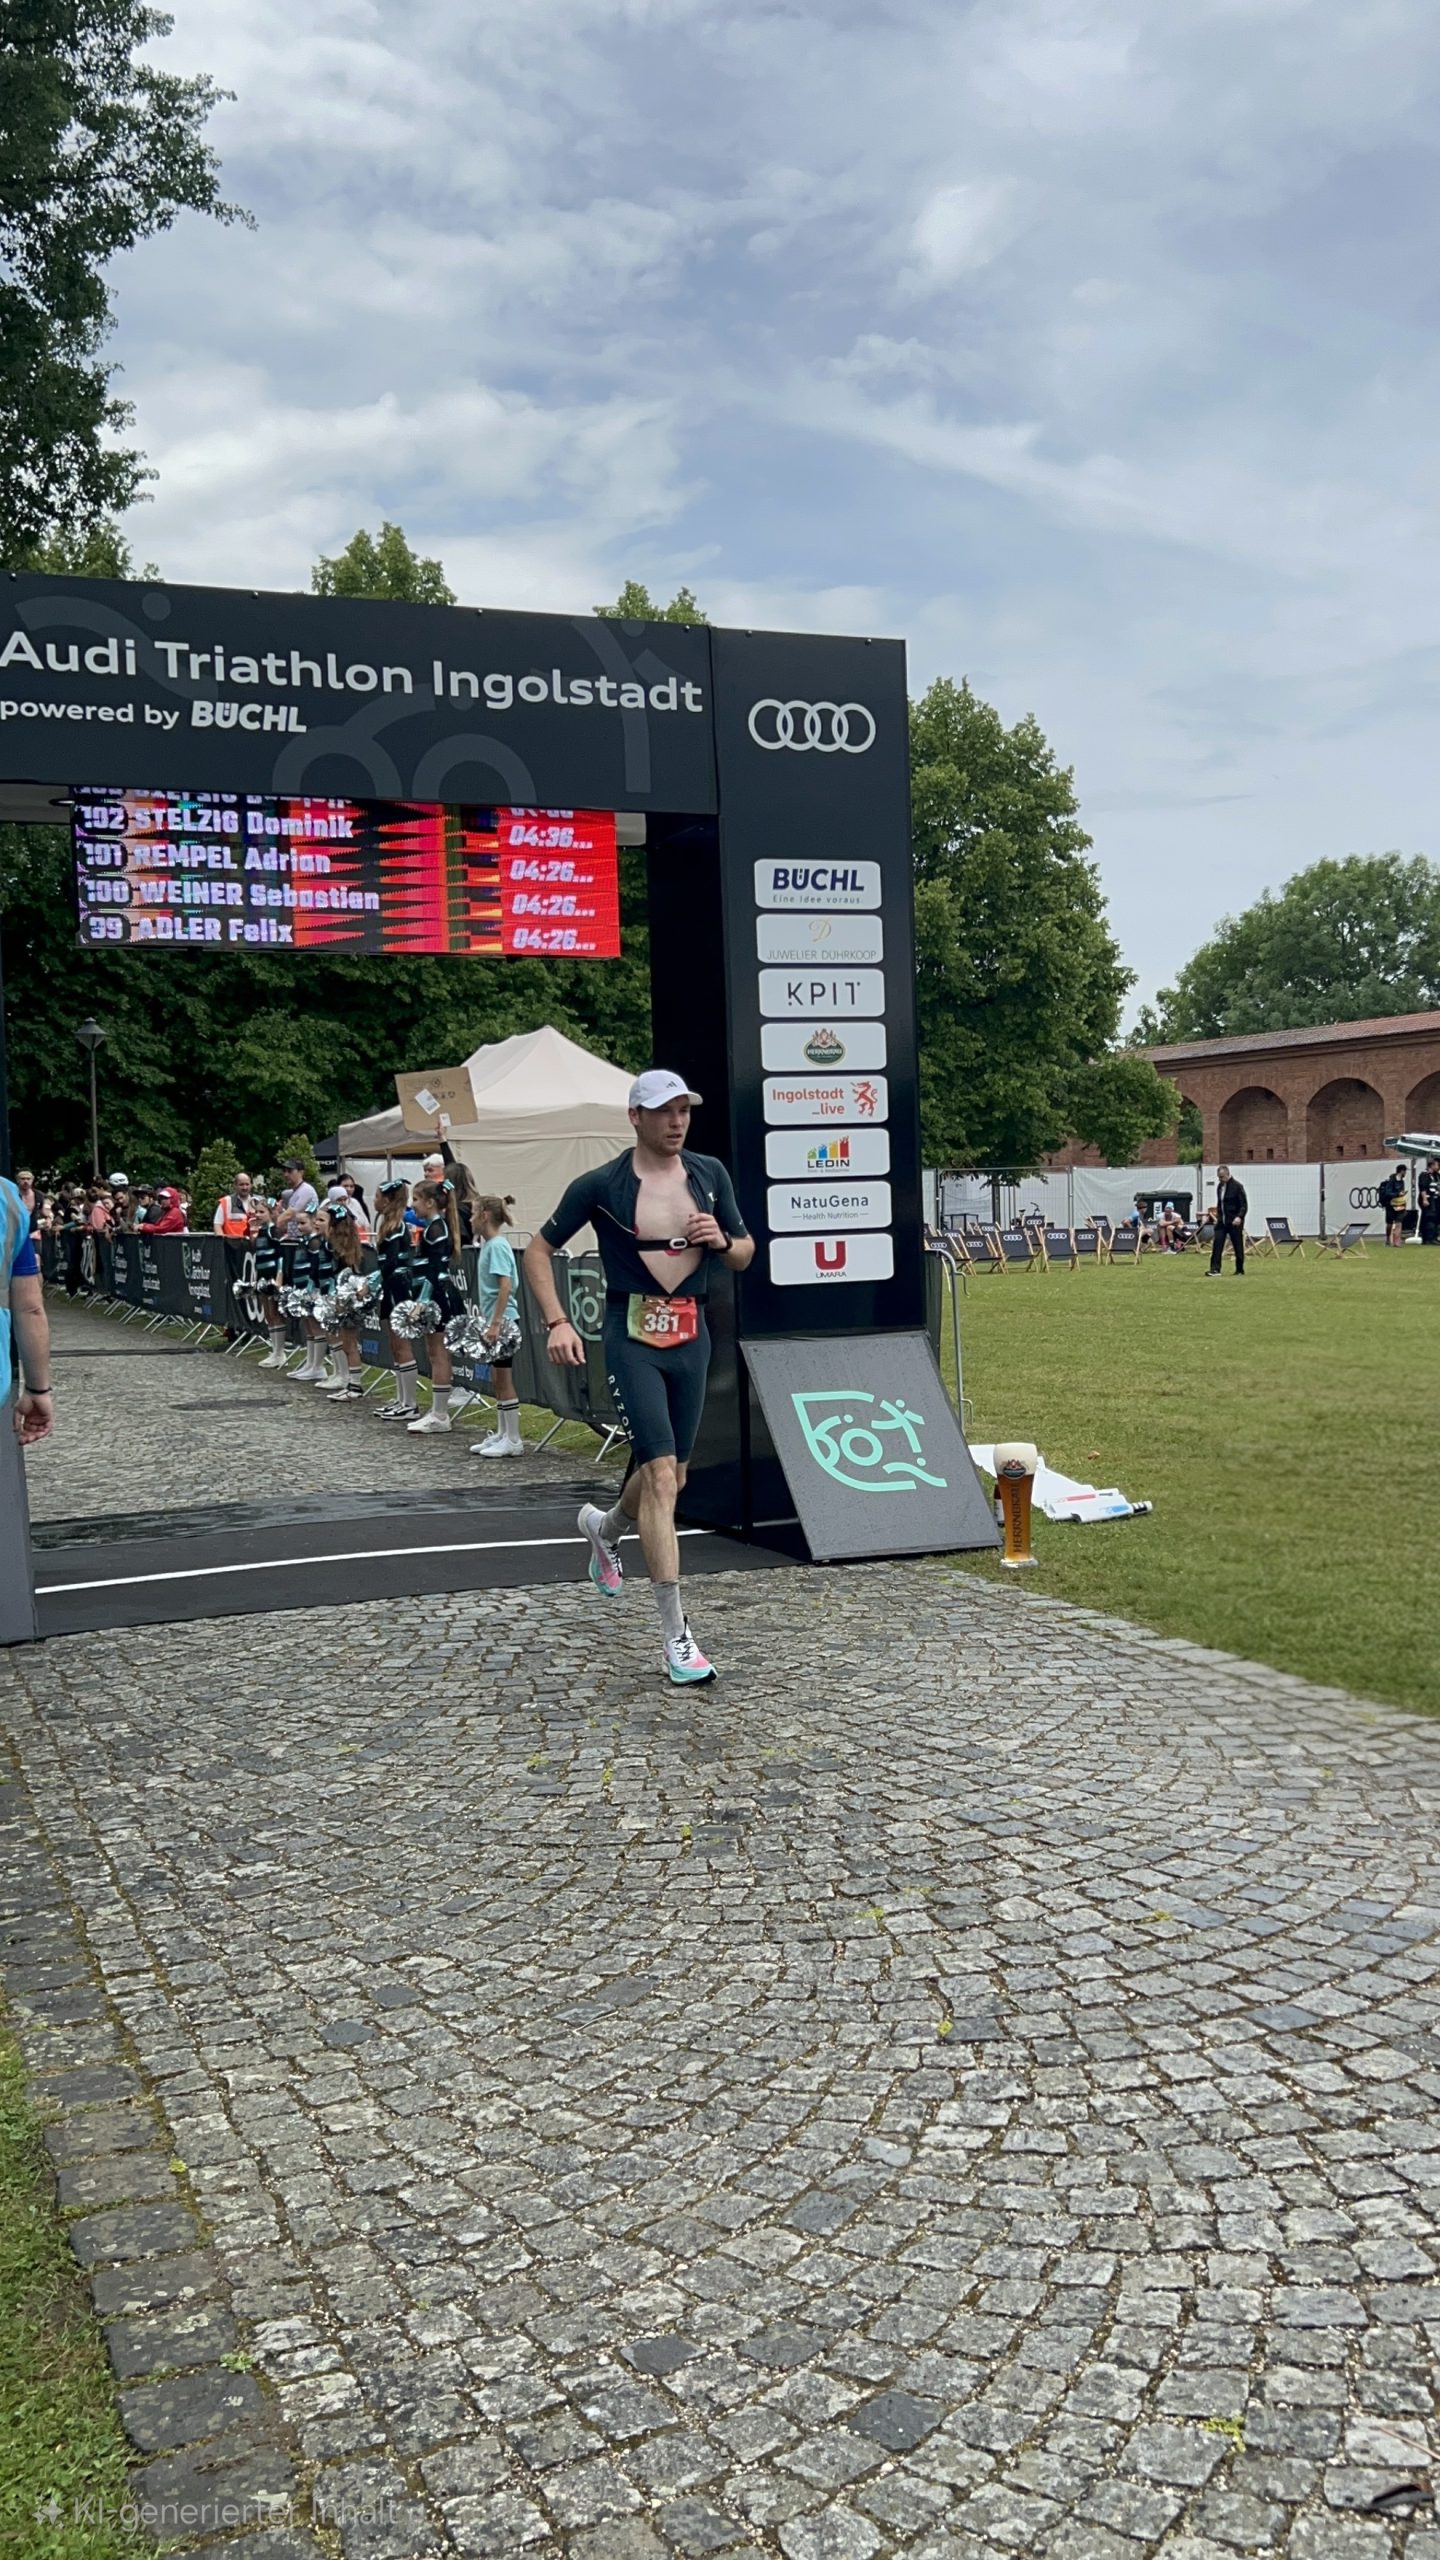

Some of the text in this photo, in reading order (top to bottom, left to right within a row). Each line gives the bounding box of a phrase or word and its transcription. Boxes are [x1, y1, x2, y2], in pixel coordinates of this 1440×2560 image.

[0, 631, 703, 712] Audi Triathlon Ingolstadt
[0, 700, 307, 733] powered by BÜCHL
[134, 809, 239, 834] STELZIG
[247, 816, 354, 838] Dominik
[133, 845, 237, 870] REMPEL
[244, 847, 331, 873] Adrian
[772, 867, 865, 892] BÜCHL
[139, 881, 243, 906] WEINER
[249, 884, 381, 911] Sebastian
[772, 894, 795, 903] Eine
[799, 895, 822, 904] Idee
[136, 916, 222, 941] ADLER
[228, 918, 294, 943] Felix
[767, 949, 818, 961] JUWELIER
[787, 982, 861, 1006] KPIT
[772, 1087, 845, 1103] Ingolstadt
[807, 1159, 850, 1168] LEDIN
[791, 1195, 869, 1209] NatuGena
[802, 1211, 859, 1220] Health Nutrition
[815, 1271, 847, 1279] UMARA
[643, 1313, 680, 1333] 381
[607, 1374, 635, 1441] RYZON
